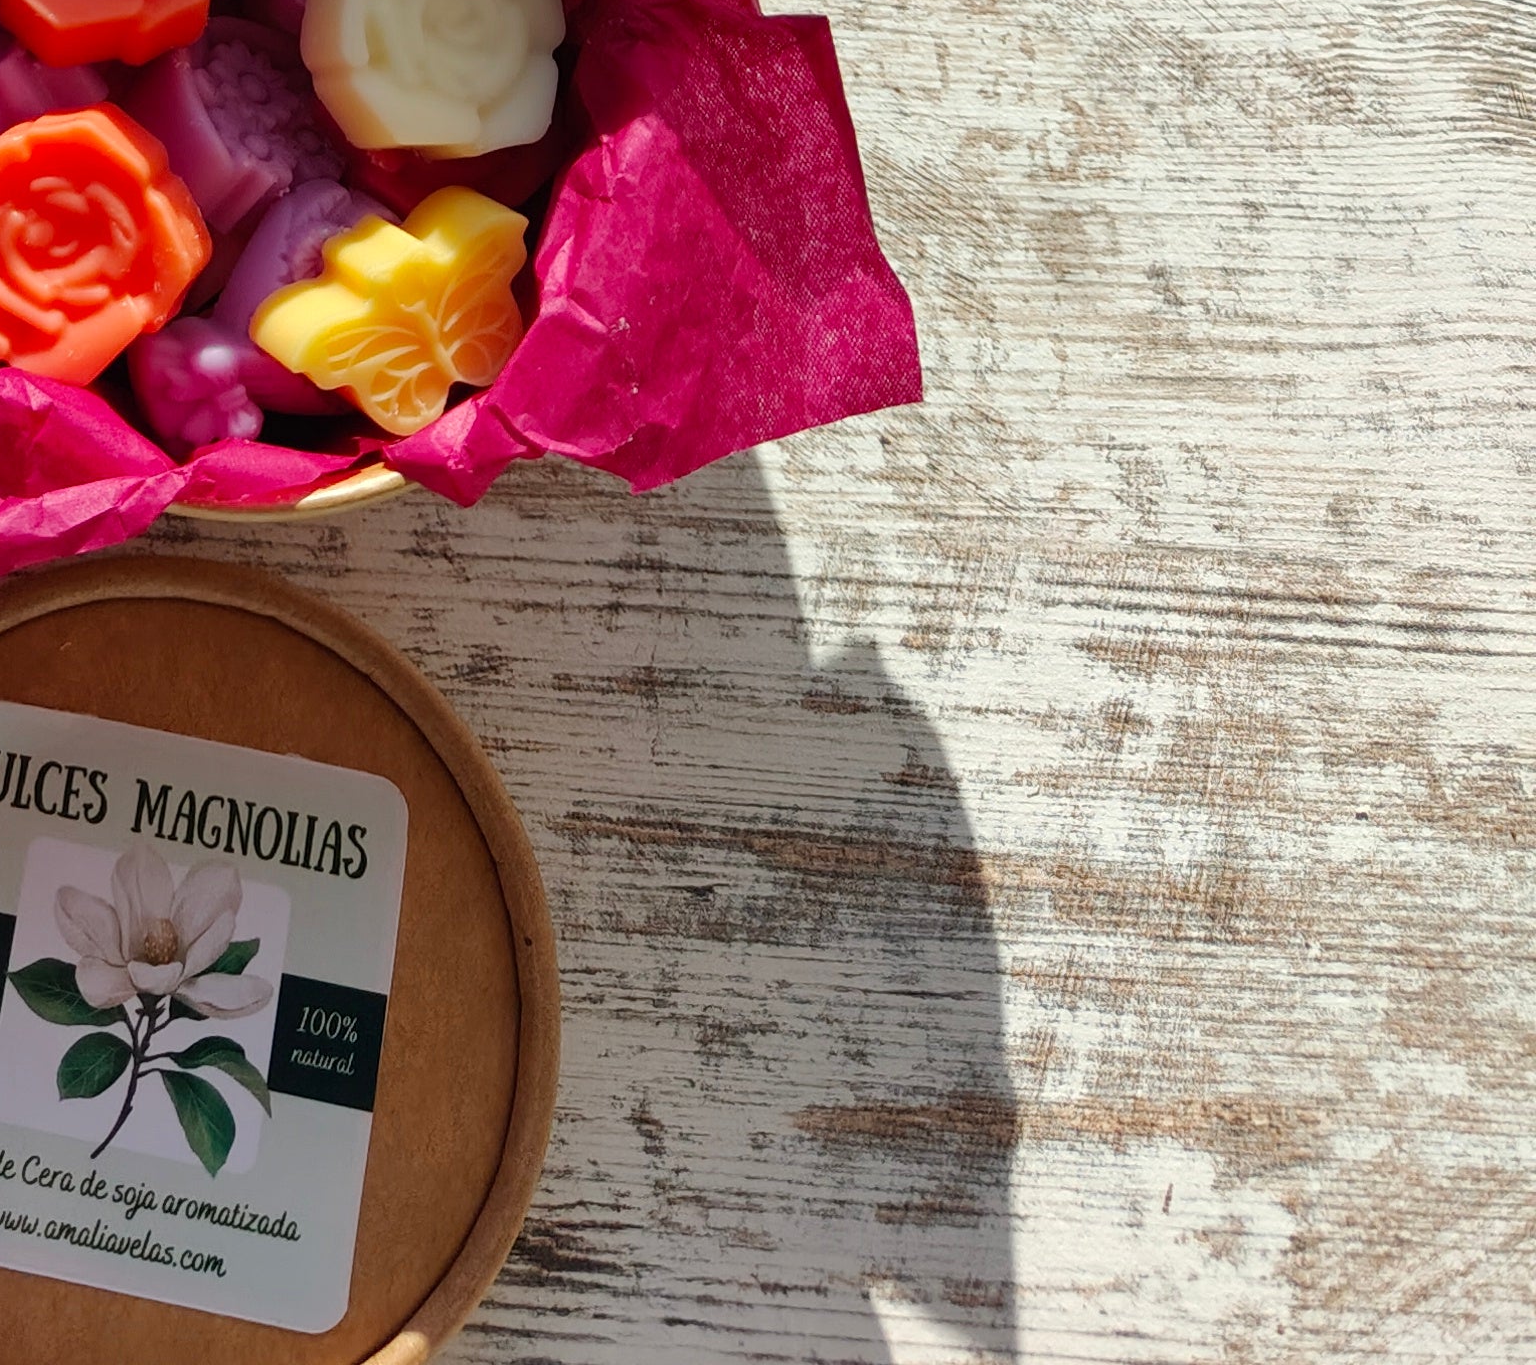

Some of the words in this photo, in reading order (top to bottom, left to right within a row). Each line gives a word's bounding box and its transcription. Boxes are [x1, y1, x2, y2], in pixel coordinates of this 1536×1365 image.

[130, 778, 369, 879] MAGNOLIAS
[295, 1005, 359, 1044] 100%
[290, 1046, 356, 1077] natural
[21, 1155, 76, 1193] Cera
[80, 1170, 109, 1200] de
[112, 1182, 158, 1220] soja
[162, 1193, 302, 1242] aromatizada
